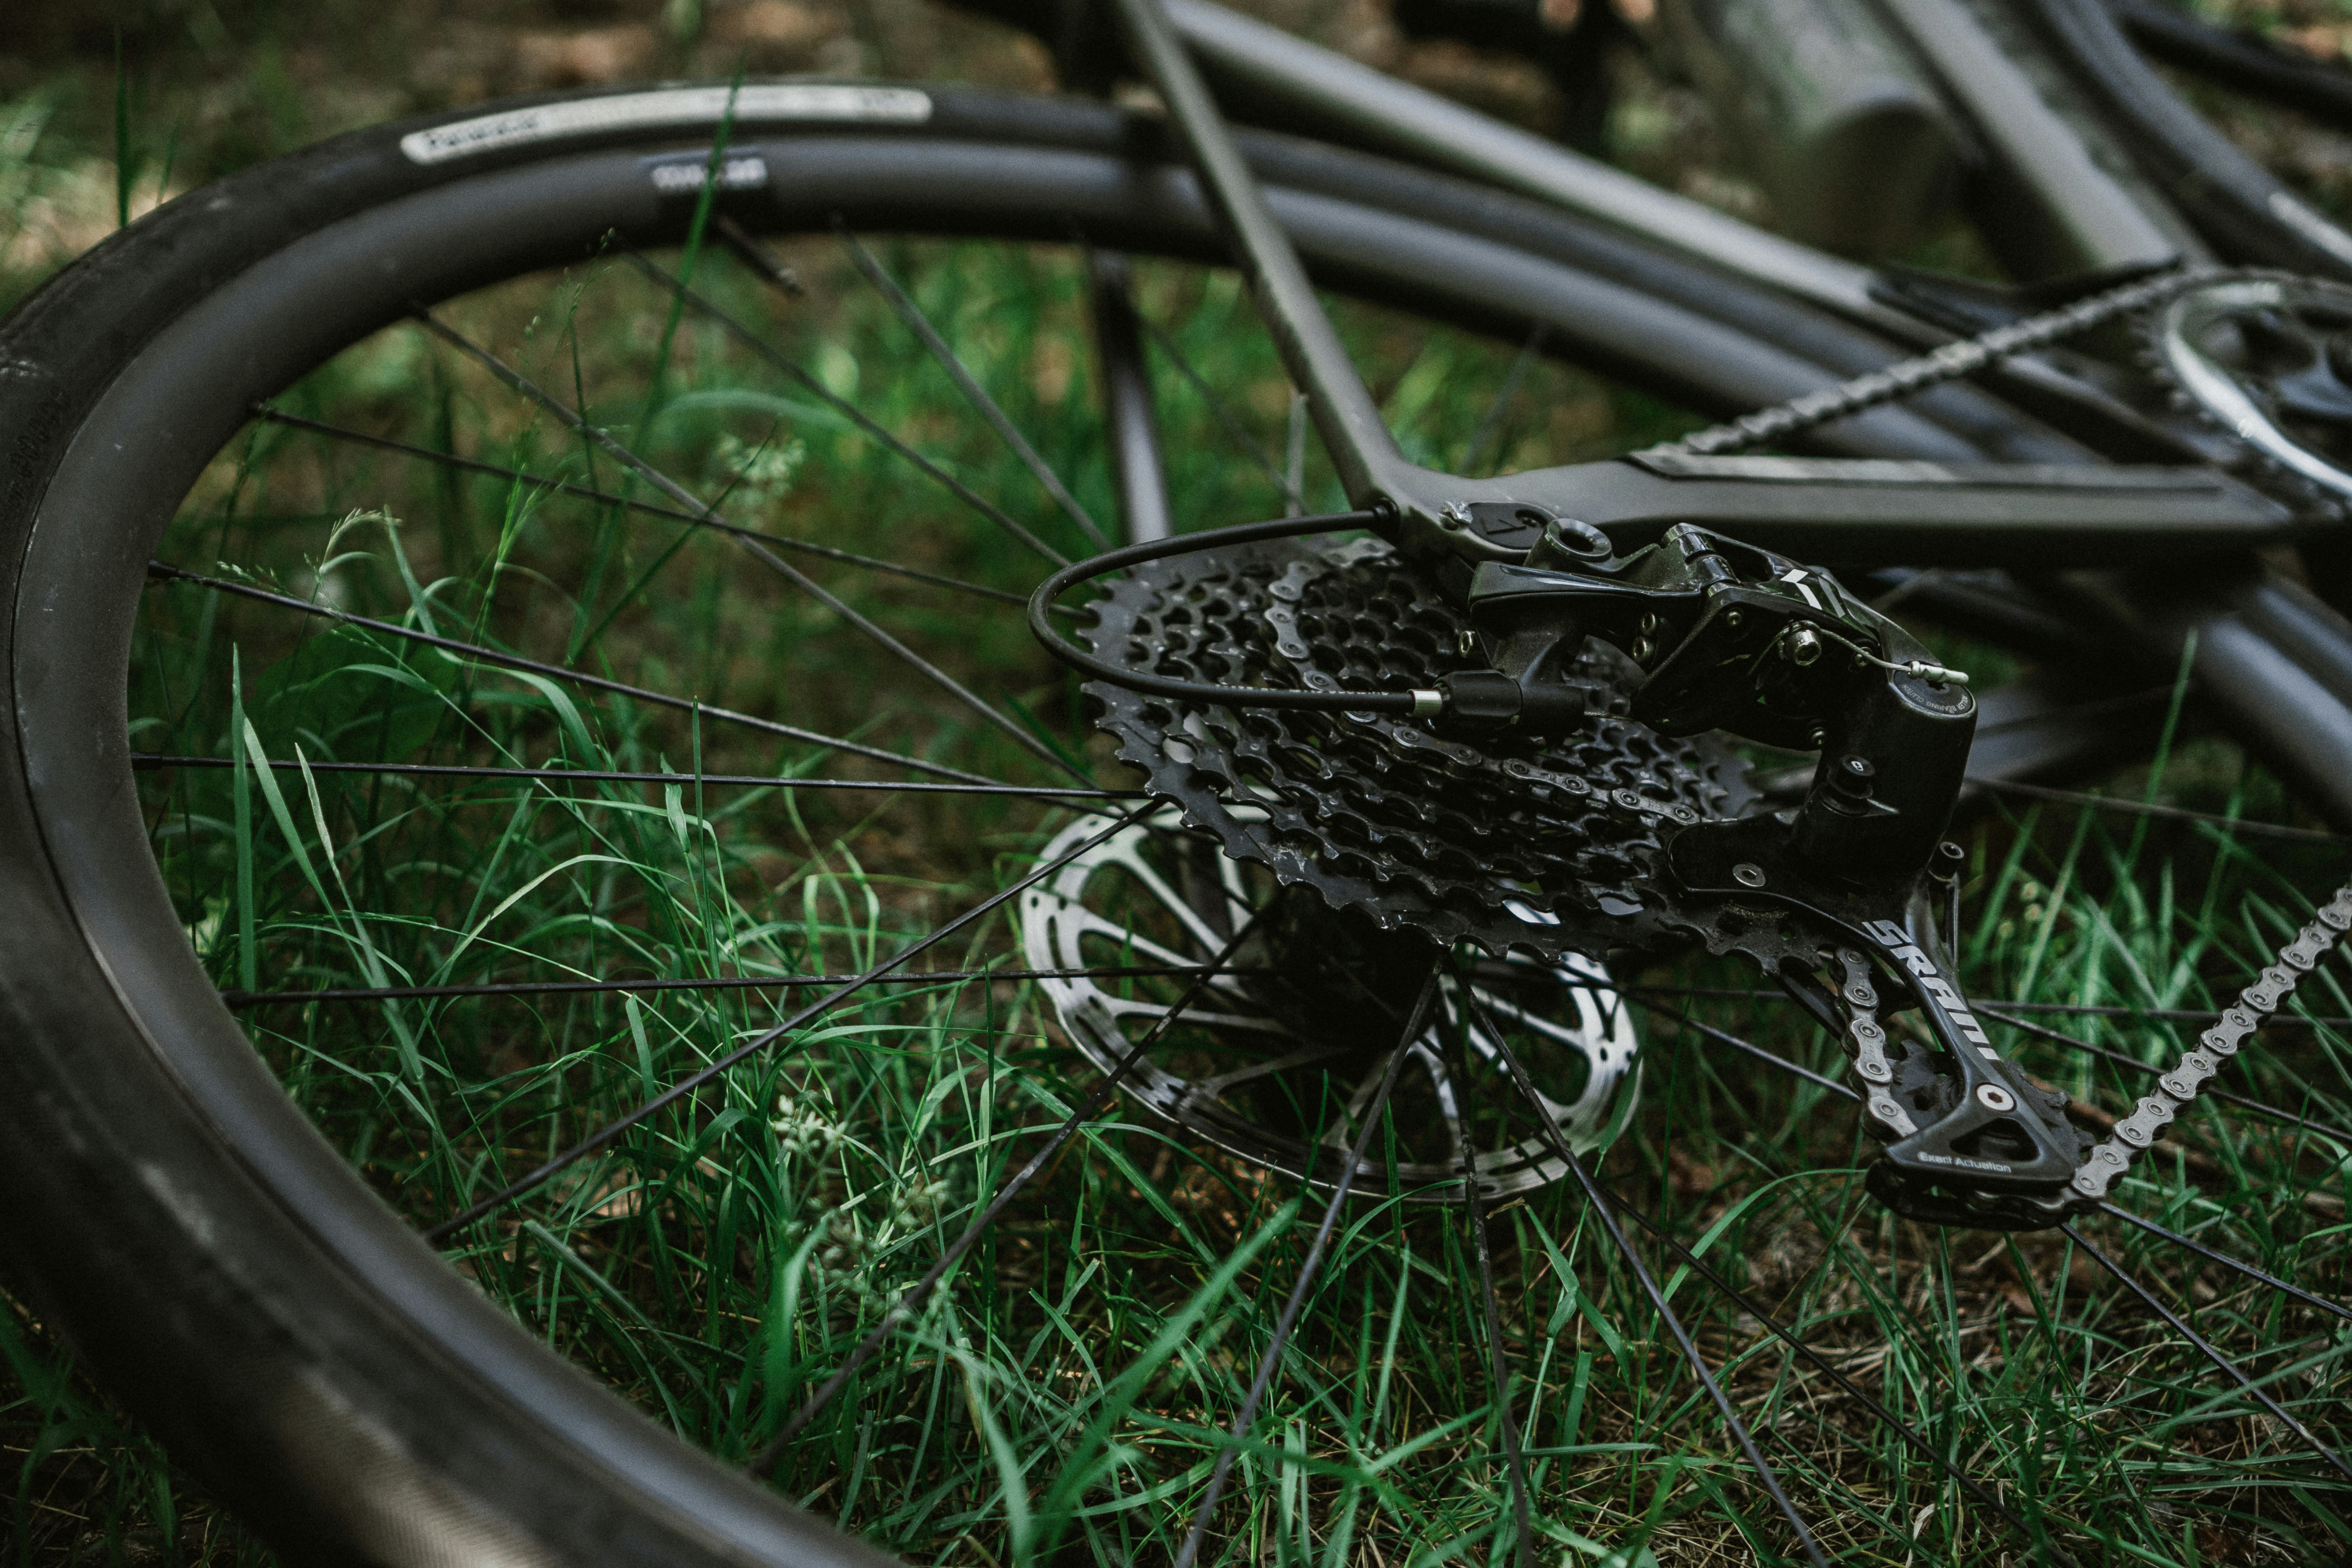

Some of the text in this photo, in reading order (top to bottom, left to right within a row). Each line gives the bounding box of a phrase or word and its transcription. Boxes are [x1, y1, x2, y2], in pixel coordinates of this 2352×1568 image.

[1902, 684, 1924, 702] CLUTCH
[1926, 701, 1957, 711] BEARING
[1862, 920, 2000, 1060] SRAM
[1918, 1152, 2011, 1173] Exact Actuation
